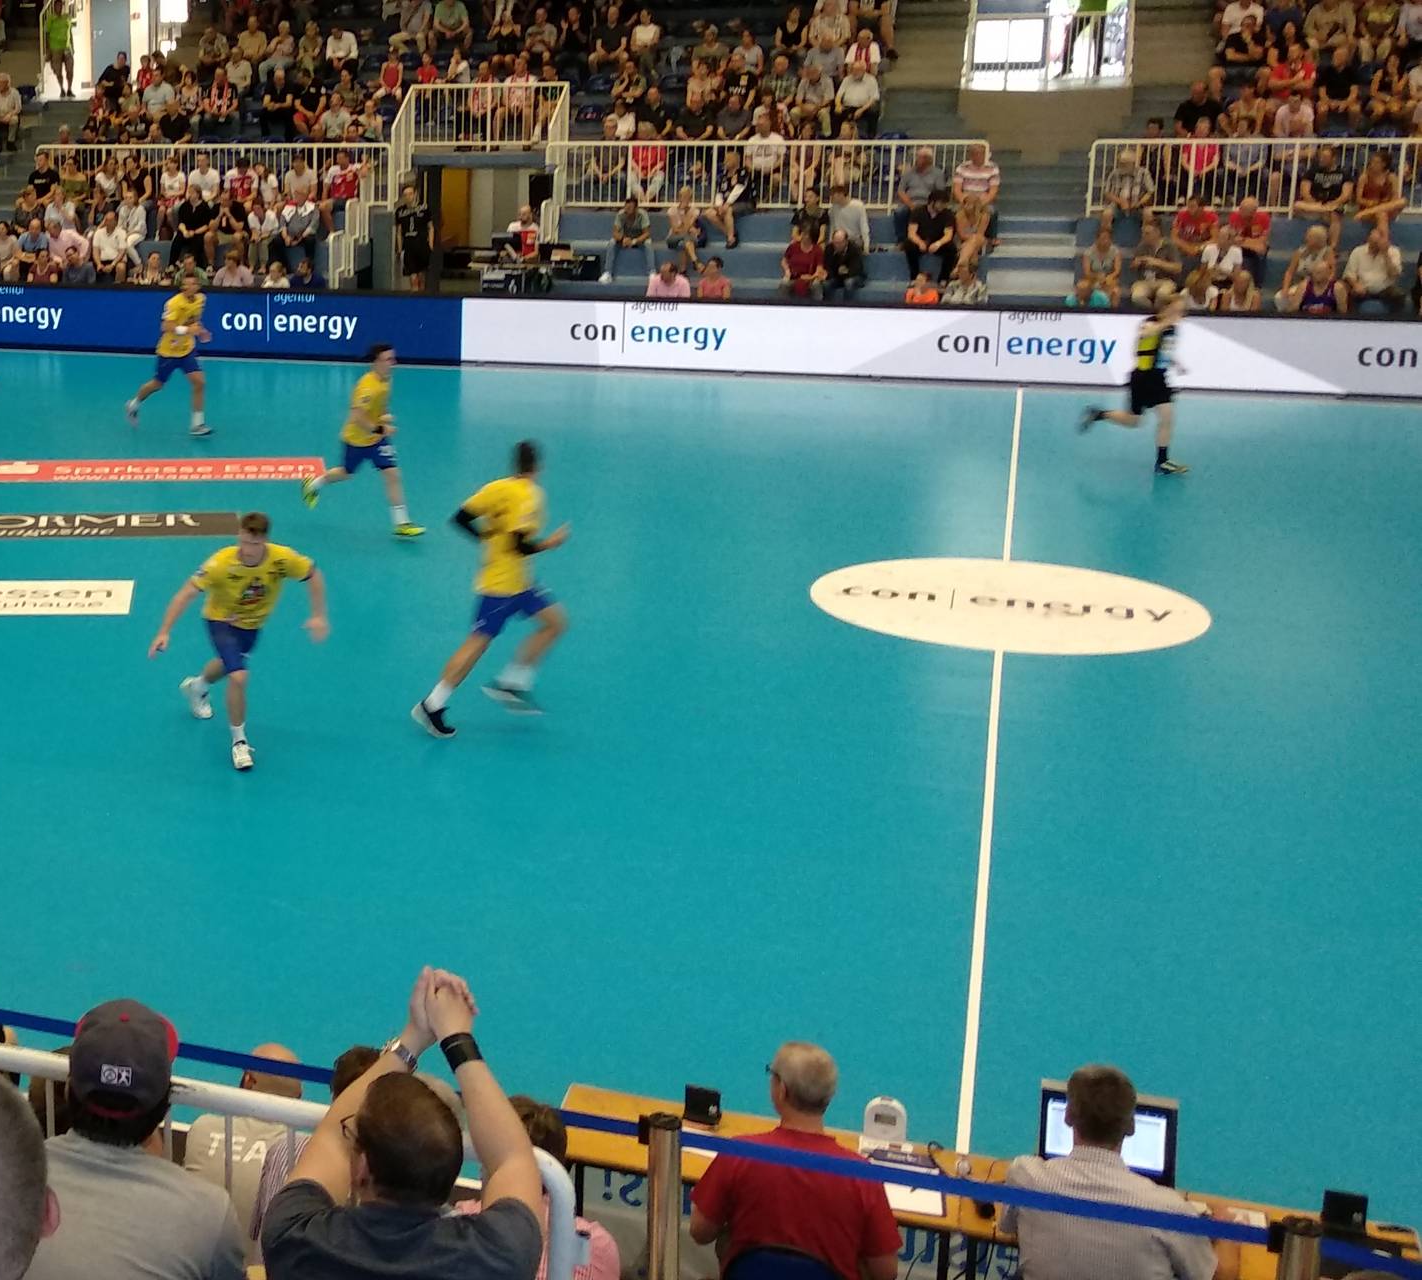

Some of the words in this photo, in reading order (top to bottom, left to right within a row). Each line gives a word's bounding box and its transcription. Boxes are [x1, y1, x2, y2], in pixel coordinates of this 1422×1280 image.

[221, 311, 263, 332] con
[273, 312, 358, 341] energy
[569, 322, 617, 342] con
[630, 323, 727, 351] energy
[937, 332, 990, 354] con
[1006, 332, 1117, 365] energy
[1358, 346, 1418, 368] con
[54, 464, 213, 476] Sparkasse
[224, 463, 315, 474] Essen
[842, 585, 937, 602] con
[969, 595, 1173, 622] energy
[208, 1133, 267, 1164] TEA
